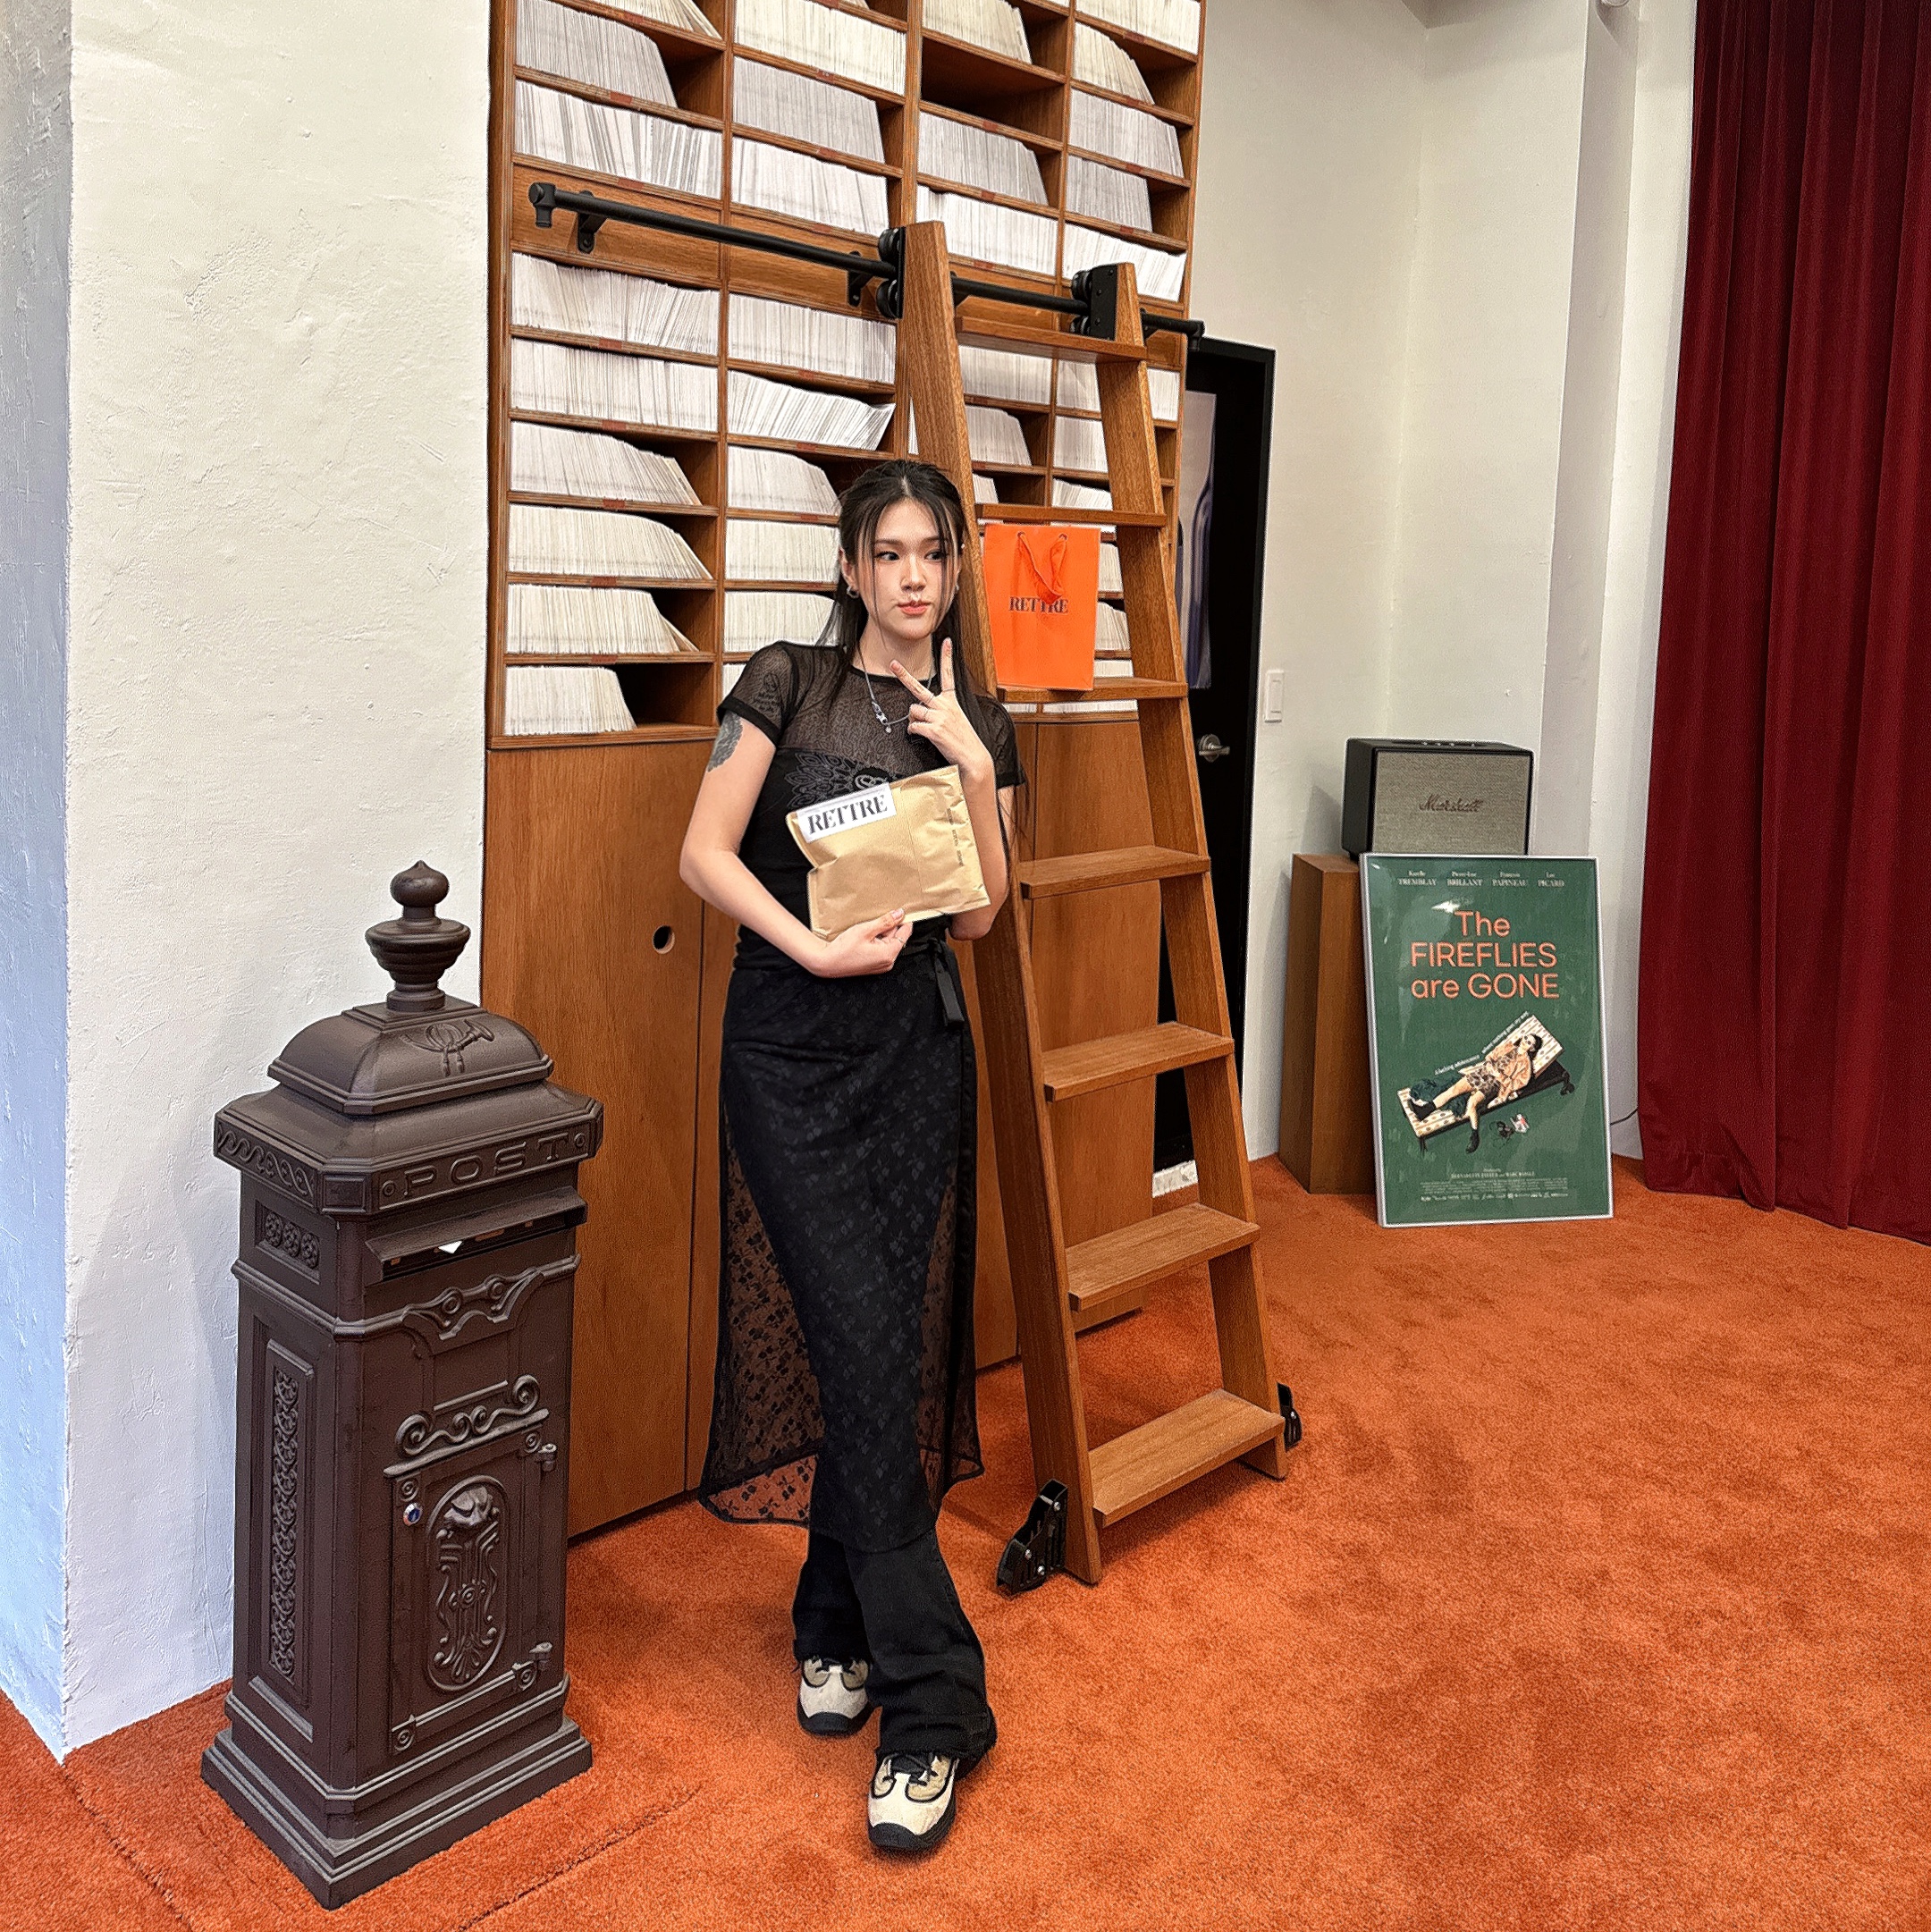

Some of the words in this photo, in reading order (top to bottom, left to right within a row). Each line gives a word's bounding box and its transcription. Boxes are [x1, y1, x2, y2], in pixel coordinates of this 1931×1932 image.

[807, 794, 888, 835] RETTRE
[1538, 879, 1564, 887] PICARD
[1455, 910, 1511, 938] The
[1411, 941, 1557, 968] FIREFLIES
[1411, 978, 1460, 1000] are
[1467, 972, 1560, 1000] GONE
[403, 1131, 569, 1197] POST
